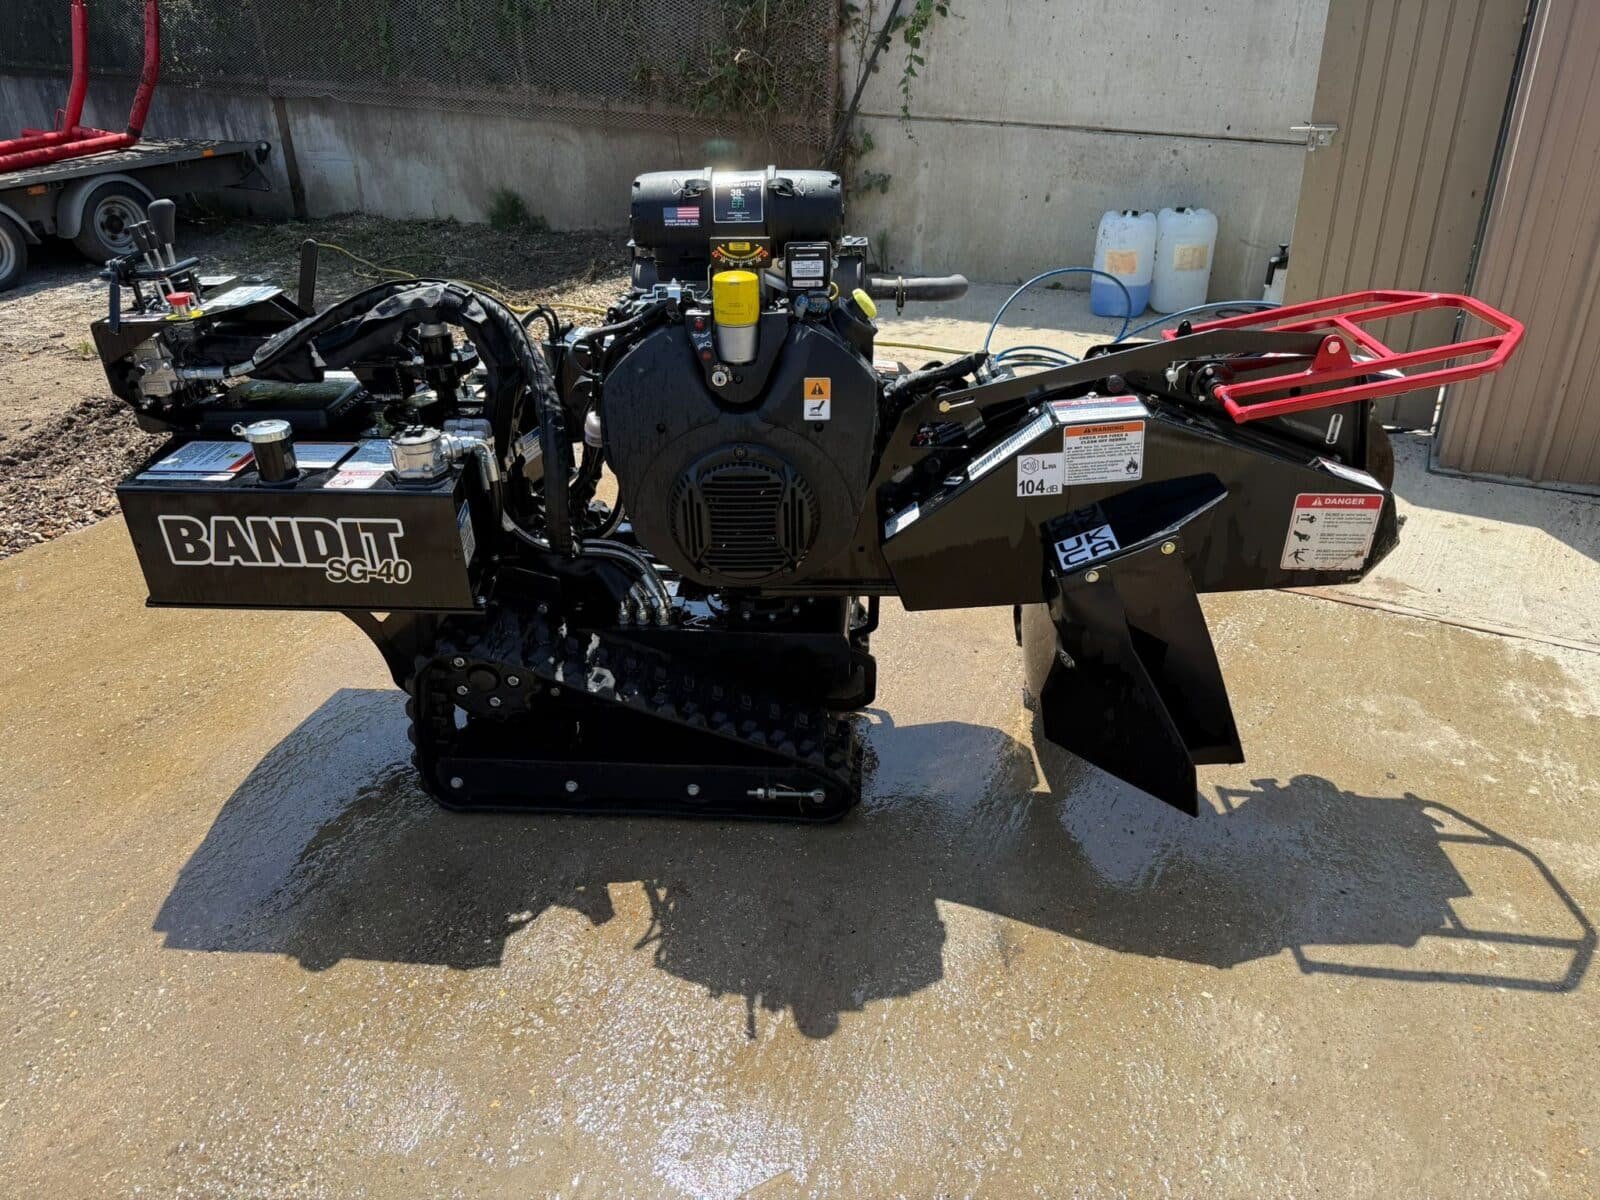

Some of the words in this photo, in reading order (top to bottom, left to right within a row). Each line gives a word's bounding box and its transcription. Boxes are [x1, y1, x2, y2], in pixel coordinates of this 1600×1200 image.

[1091, 425, 1125, 433] WARNING
[1018, 479, 1046, 495] 104
[1046, 484, 1059, 493] dB
[1324, 497, 1366, 505] DANGER
[158, 515, 405, 568] BANDIT
[1057, 527, 1112, 553] UK
[326, 557, 412, 585] SG-40
